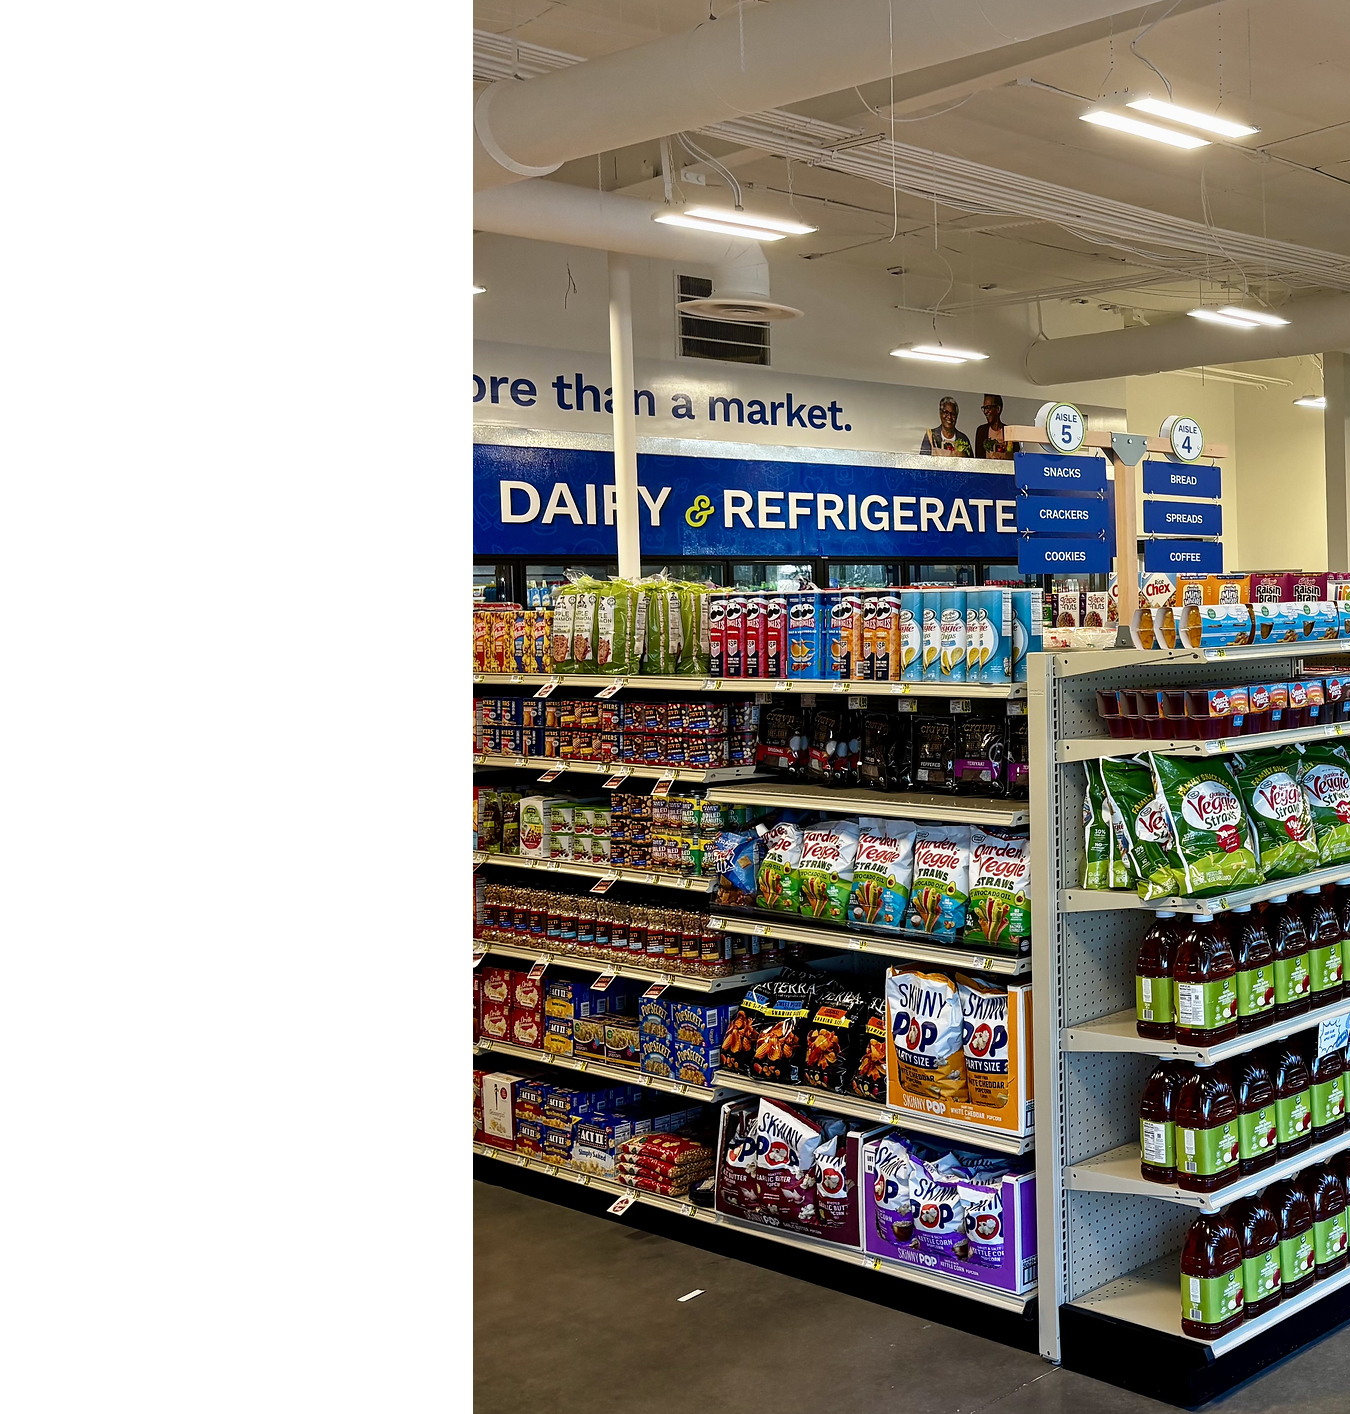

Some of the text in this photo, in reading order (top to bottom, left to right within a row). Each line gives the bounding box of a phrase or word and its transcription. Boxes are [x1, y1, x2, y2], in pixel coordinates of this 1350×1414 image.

[671, 393, 695, 420] a
[708, 393, 852, 432] market.
[1055, 413, 1077, 424] AISLE
[1061, 424, 1072, 444] 5
[1178, 424, 1198, 435] AISLE
[1181, 436, 1192, 454] 4
[1043, 466, 1081, 479] SNACKS
[1170, 474, 1197, 486] BREAD
[685, 495, 715, 528] &
[1039, 509, 1089, 521] CRACKERS
[1166, 513, 1203, 525] SPREADS
[1044, 551, 1086, 561] COOKIES
[1169, 553, 1201, 563] COFFEE
[1146, 584, 1170, 596] Chex
[1256, 586, 1281, 595] Raisin
[1294, 585, 1320, 595] Raisin
[1251, 768, 1272, 787] FAMILY
[1177, 775, 1200, 796] FAMILY
[1304, 775, 1350, 800] Veggie
[1132, 793, 1154, 815] FAMILY
[1187, 795, 1239, 821] Veggie
[1204, 811, 1238, 829] Straws
[856, 844, 900, 864] Veggie
[916, 850, 960, 870] Veggie
[800, 860, 832, 871] STRAWS
[854, 862, 888, 874] STRAWS
[979, 857, 1026, 878] Veggie
[918, 868, 949, 881] TRAWS
[974, 876, 1015, 890] STRAWS
[973, 889, 1011, 901] AVOCADO OIL
[898, 983, 947, 1018] SKINNY
[893, 1011, 938, 1052] POP
[962, 1021, 1008, 1058] POP
[913, 1053, 930, 1068] SIZE
[984, 1060, 1000, 1072] SIZE
[909, 1071, 935, 1083] CHEDDAR
[978, 1080, 1005, 1089] CHEDDAR
[902, 1093, 947, 1115] SKINNY POP
[964, 1109, 985, 1120] CHEDDAR
[580, 1129, 593, 1142] ACT
[758, 1112, 803, 1147] SKINNY
[578, 1148, 606, 1162] Simply Salted
[763, 1215, 780, 1227] POP
[935, 1238, 953, 1247] CORN
[897, 1247, 938, 1267] SKINNY POP
[940, 1260, 965, 1273] KETTLE CORN
